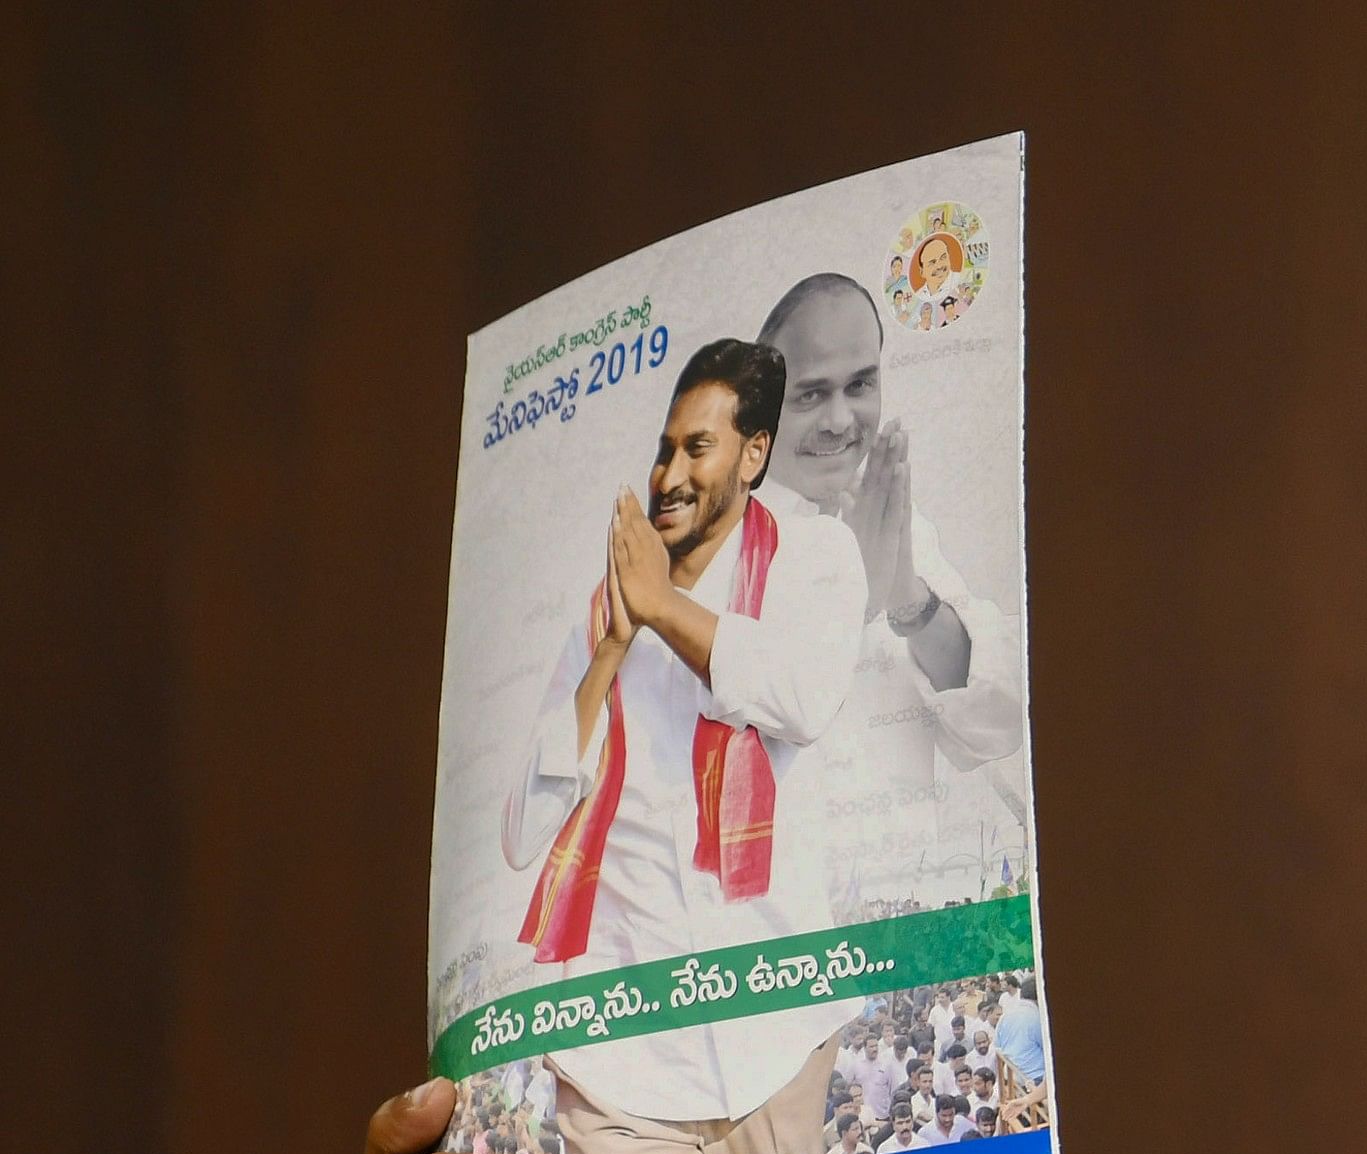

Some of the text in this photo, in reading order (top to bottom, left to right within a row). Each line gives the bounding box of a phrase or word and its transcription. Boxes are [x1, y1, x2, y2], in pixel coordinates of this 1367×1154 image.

[569, 310, 617, 352] కాంగ్రెస్
[620, 294, 652, 330] పార్టీ
[483, 324, 669, 449] మేనిఫెస్టో 2019
[471, 1004, 525, 1056] నేను
[531, 981, 661, 1038] విన్నాను..
[670, 957, 738, 1009] నేను
[746, 940, 896, 997] ఉన్నాను...
